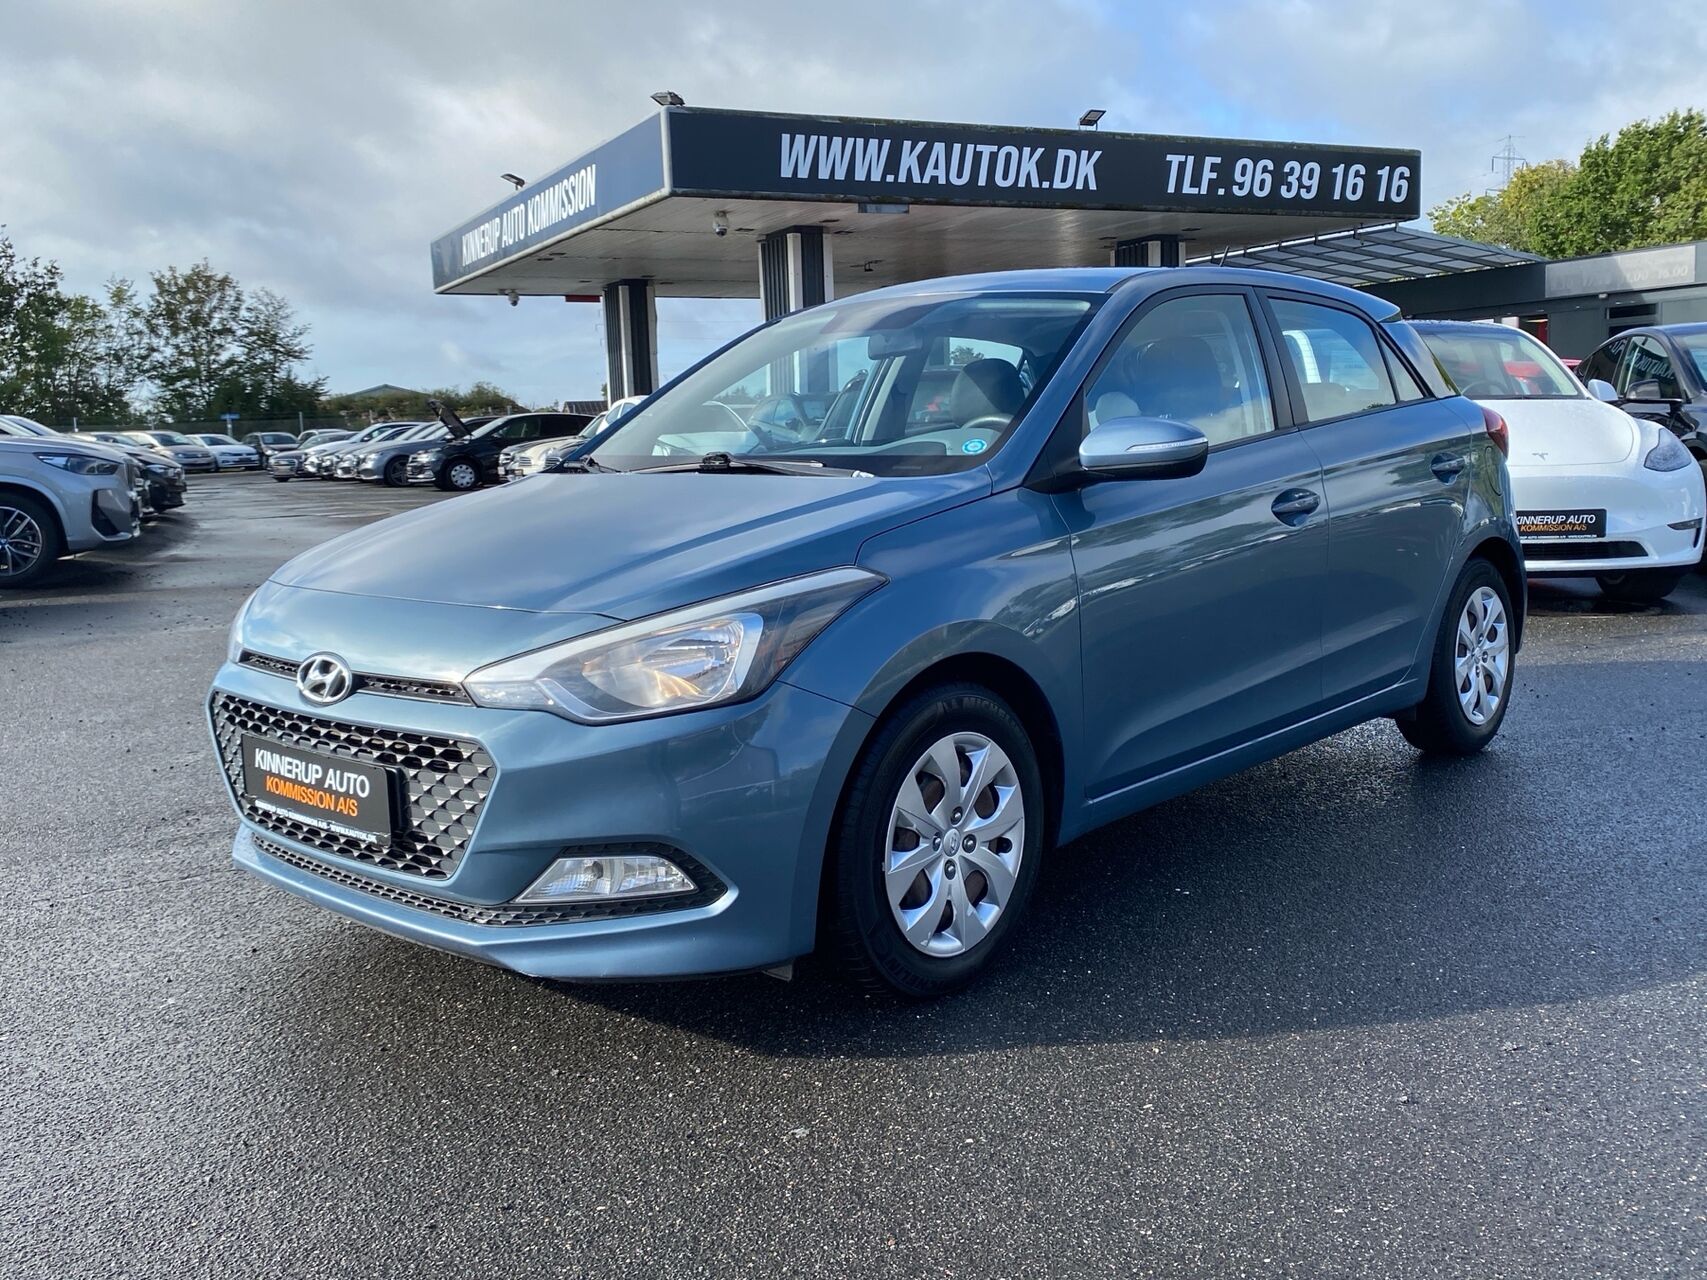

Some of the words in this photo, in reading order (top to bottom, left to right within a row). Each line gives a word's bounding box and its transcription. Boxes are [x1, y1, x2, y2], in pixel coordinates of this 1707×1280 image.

[780, 133, 1103, 191] WWW.KAUTOK.DK
[1166, 154, 1225, 196] TLF.
[1232, 157, 1274, 198] 96
[1280, 160, 1321, 200] 39
[1332, 163, 1366, 201] 16
[1377, 165, 1411, 203] 16
[461, 217, 500, 267] KINNERUP
[501, 203, 526, 248] AUTO
[527, 163, 596, 236] KOMMISSION
[1520, 524, 1572, 532] KOMMISSION
[1573, 523, 1587, 531] A/S
[1566, 514, 1596, 524] AUTO
[255, 748, 323, 785] KINNERUP
[324, 768, 370, 798] AUTO
[266, 776, 335, 811] KOMMISSION
[336, 797, 358, 817] A/S
